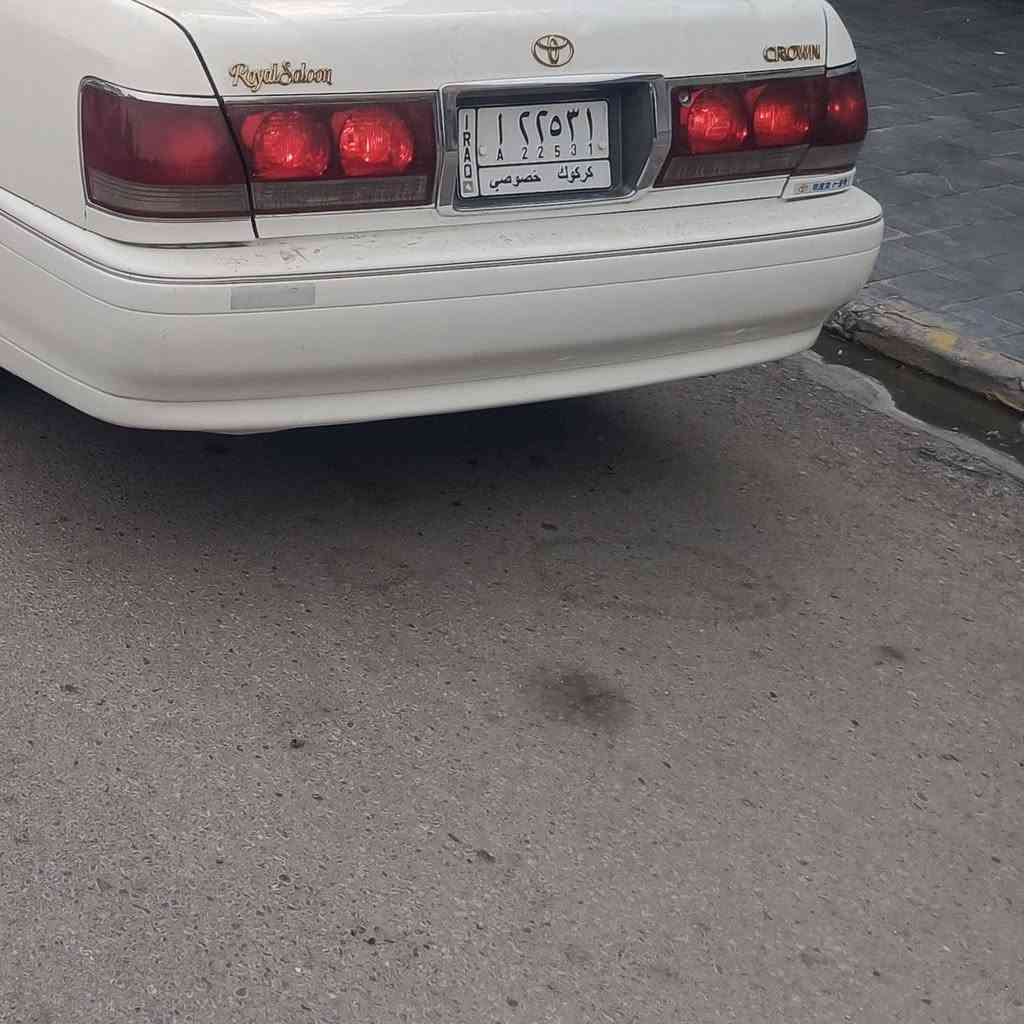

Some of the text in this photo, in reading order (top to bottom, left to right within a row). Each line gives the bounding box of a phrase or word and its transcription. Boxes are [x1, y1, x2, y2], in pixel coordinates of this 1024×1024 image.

[764, 44, 821, 62] CROWN
[462, 114, 473, 179] IRAQ
[521, 142, 594, 160] 22531
[489, 164, 595, 192] كركوك خصوصي
